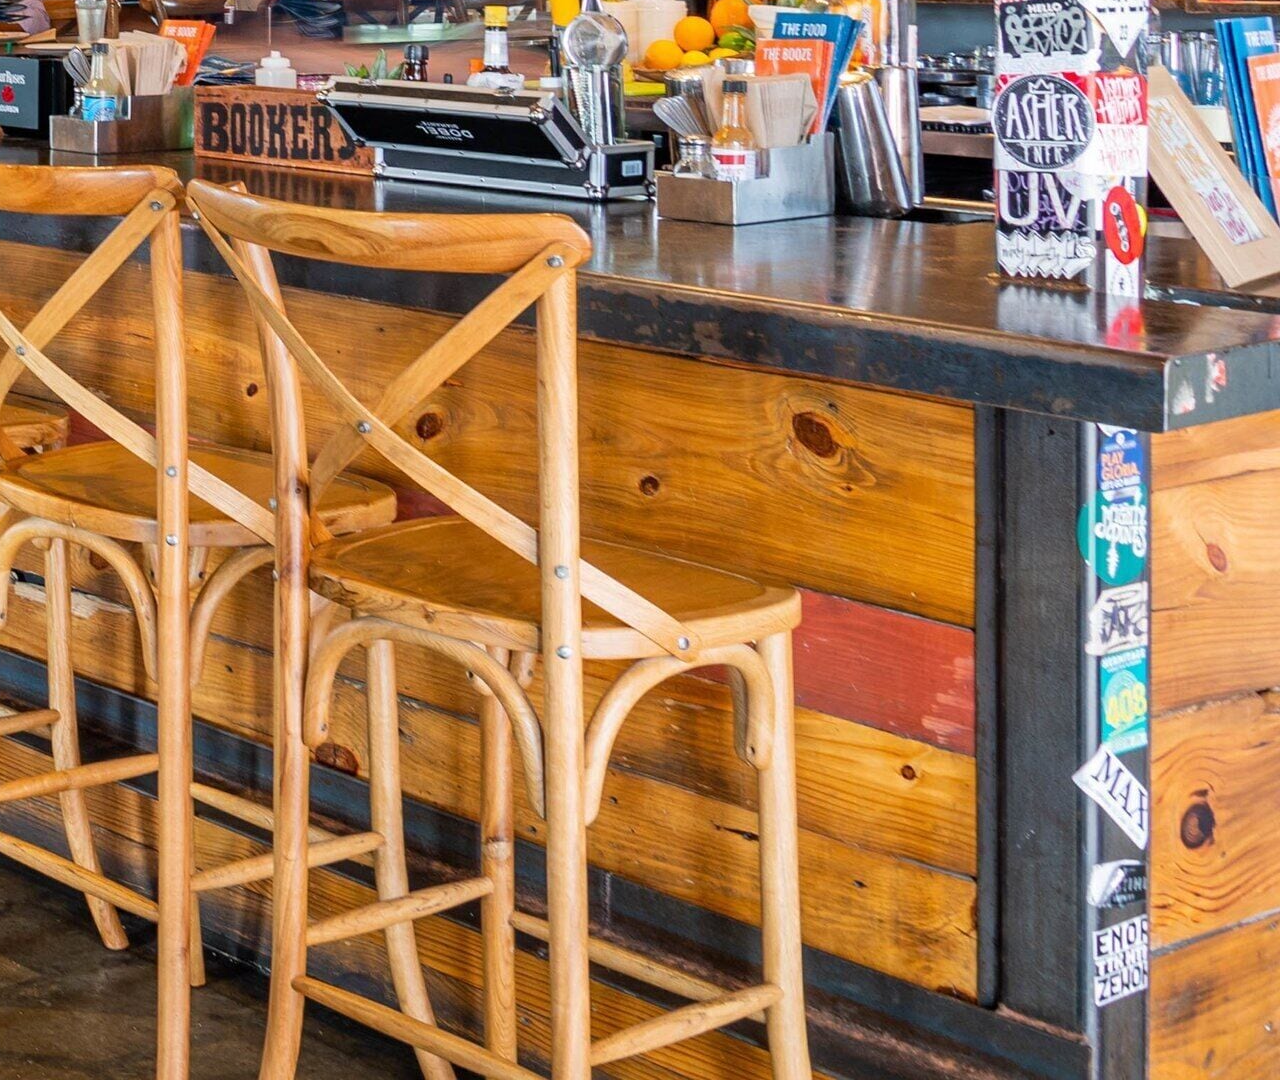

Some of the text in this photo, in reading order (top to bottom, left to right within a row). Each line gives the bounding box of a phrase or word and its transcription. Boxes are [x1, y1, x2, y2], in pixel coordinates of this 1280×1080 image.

[1027, 2, 1063, 16] HELLO
[781, 22, 828, 37] THE FOOD
[763, 47, 813, 61] THE BOOZE
[8, 71, 26, 85] Roses
[1006, 92, 1089, 142] ASHER
[415, 124, 475, 140] DOBEL
[1100, 450, 1125, 467] PLAY
